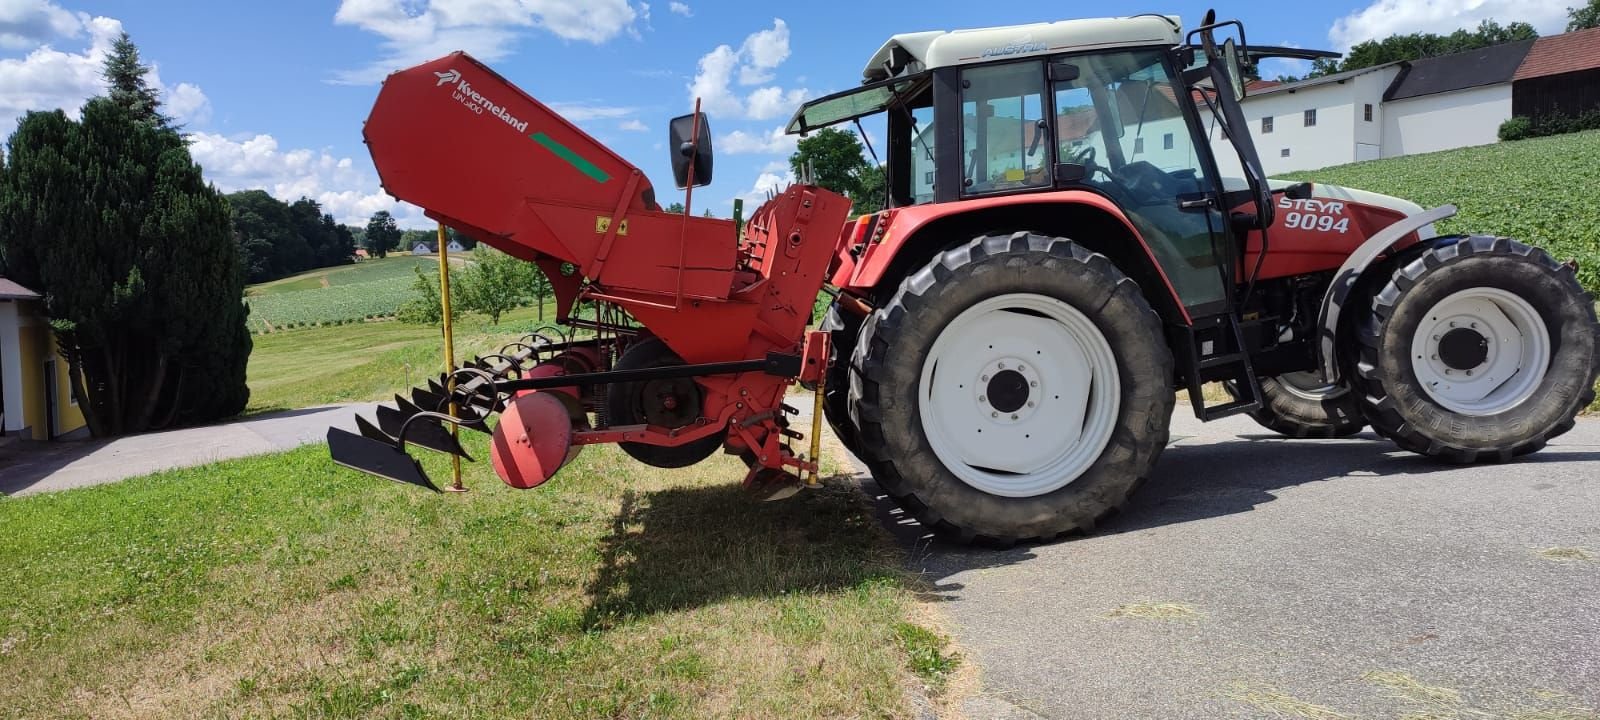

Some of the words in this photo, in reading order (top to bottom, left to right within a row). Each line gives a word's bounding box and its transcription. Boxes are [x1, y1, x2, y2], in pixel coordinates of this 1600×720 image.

[981, 41, 1047, 58] AUSTRIA
[457, 79, 528, 133] Kverneland
[1278, 196, 1344, 215] STEYR
[1284, 212, 1349, 234] 9094
